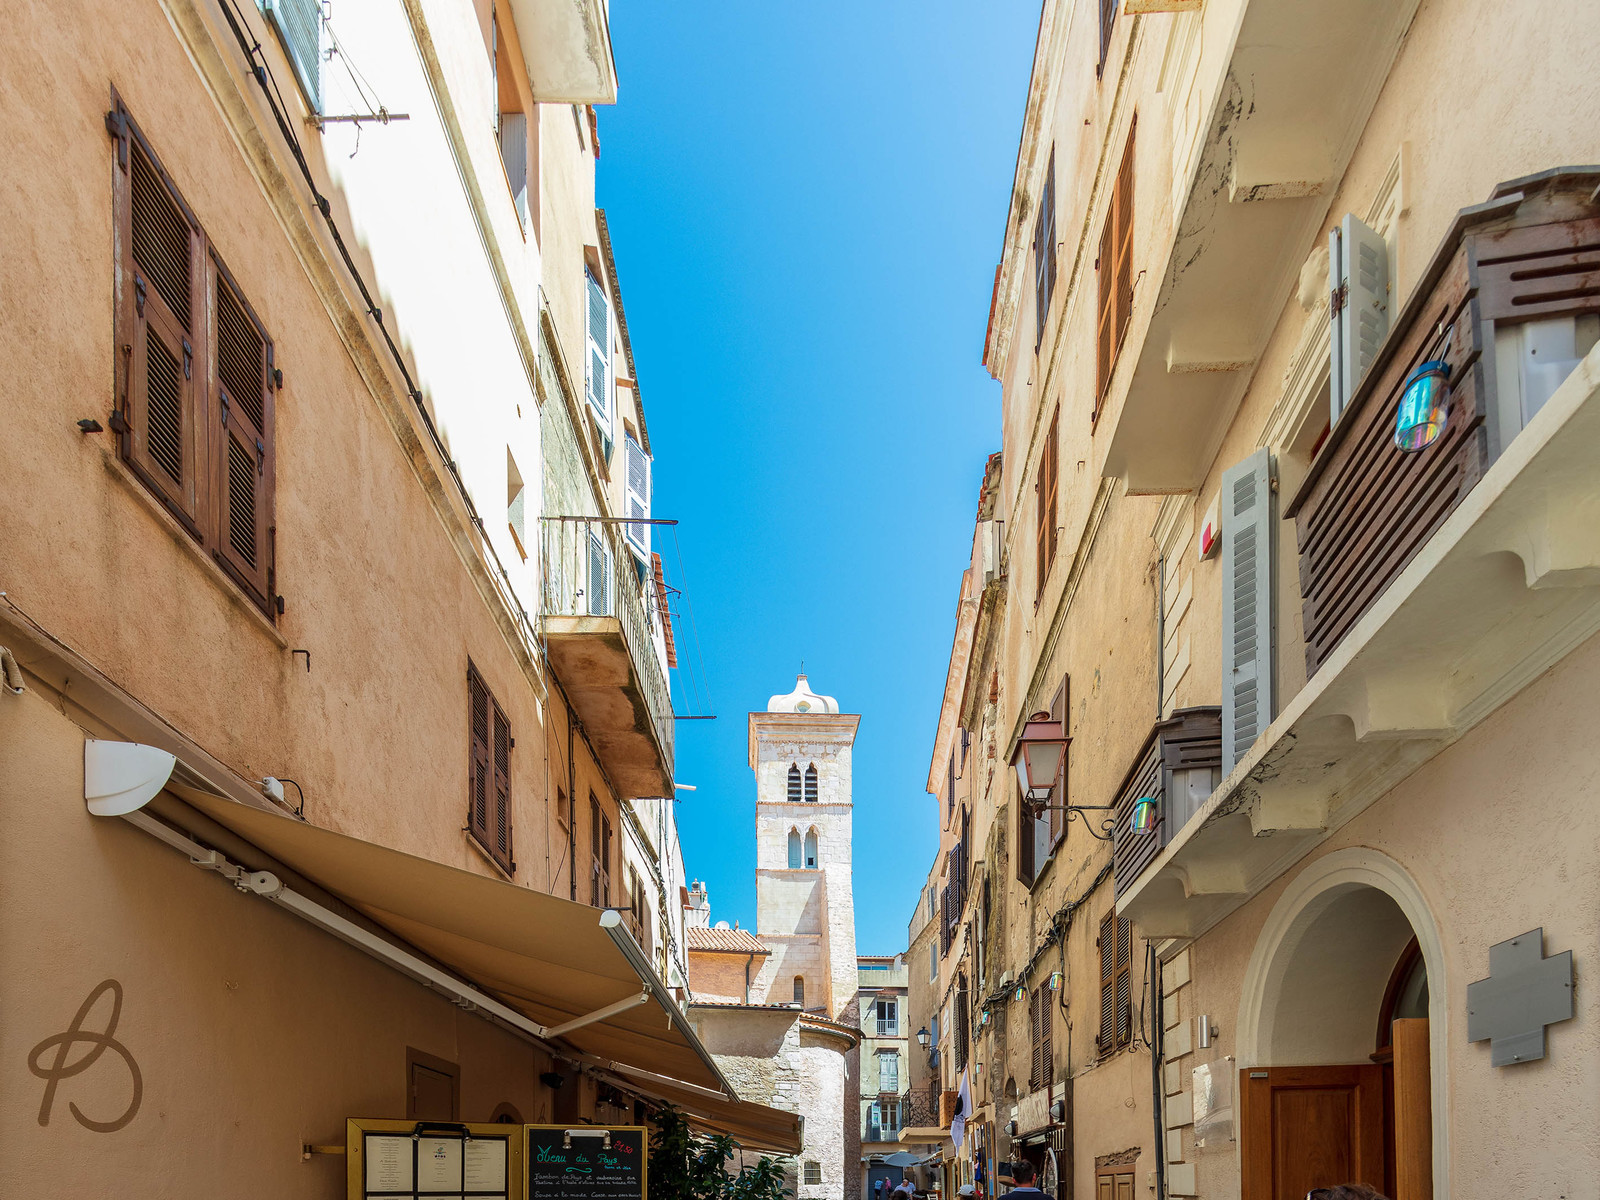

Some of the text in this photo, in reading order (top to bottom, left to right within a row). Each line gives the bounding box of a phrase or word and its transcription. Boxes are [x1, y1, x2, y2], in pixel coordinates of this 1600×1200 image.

[537, 1145, 618, 1165] Menu du Pays
